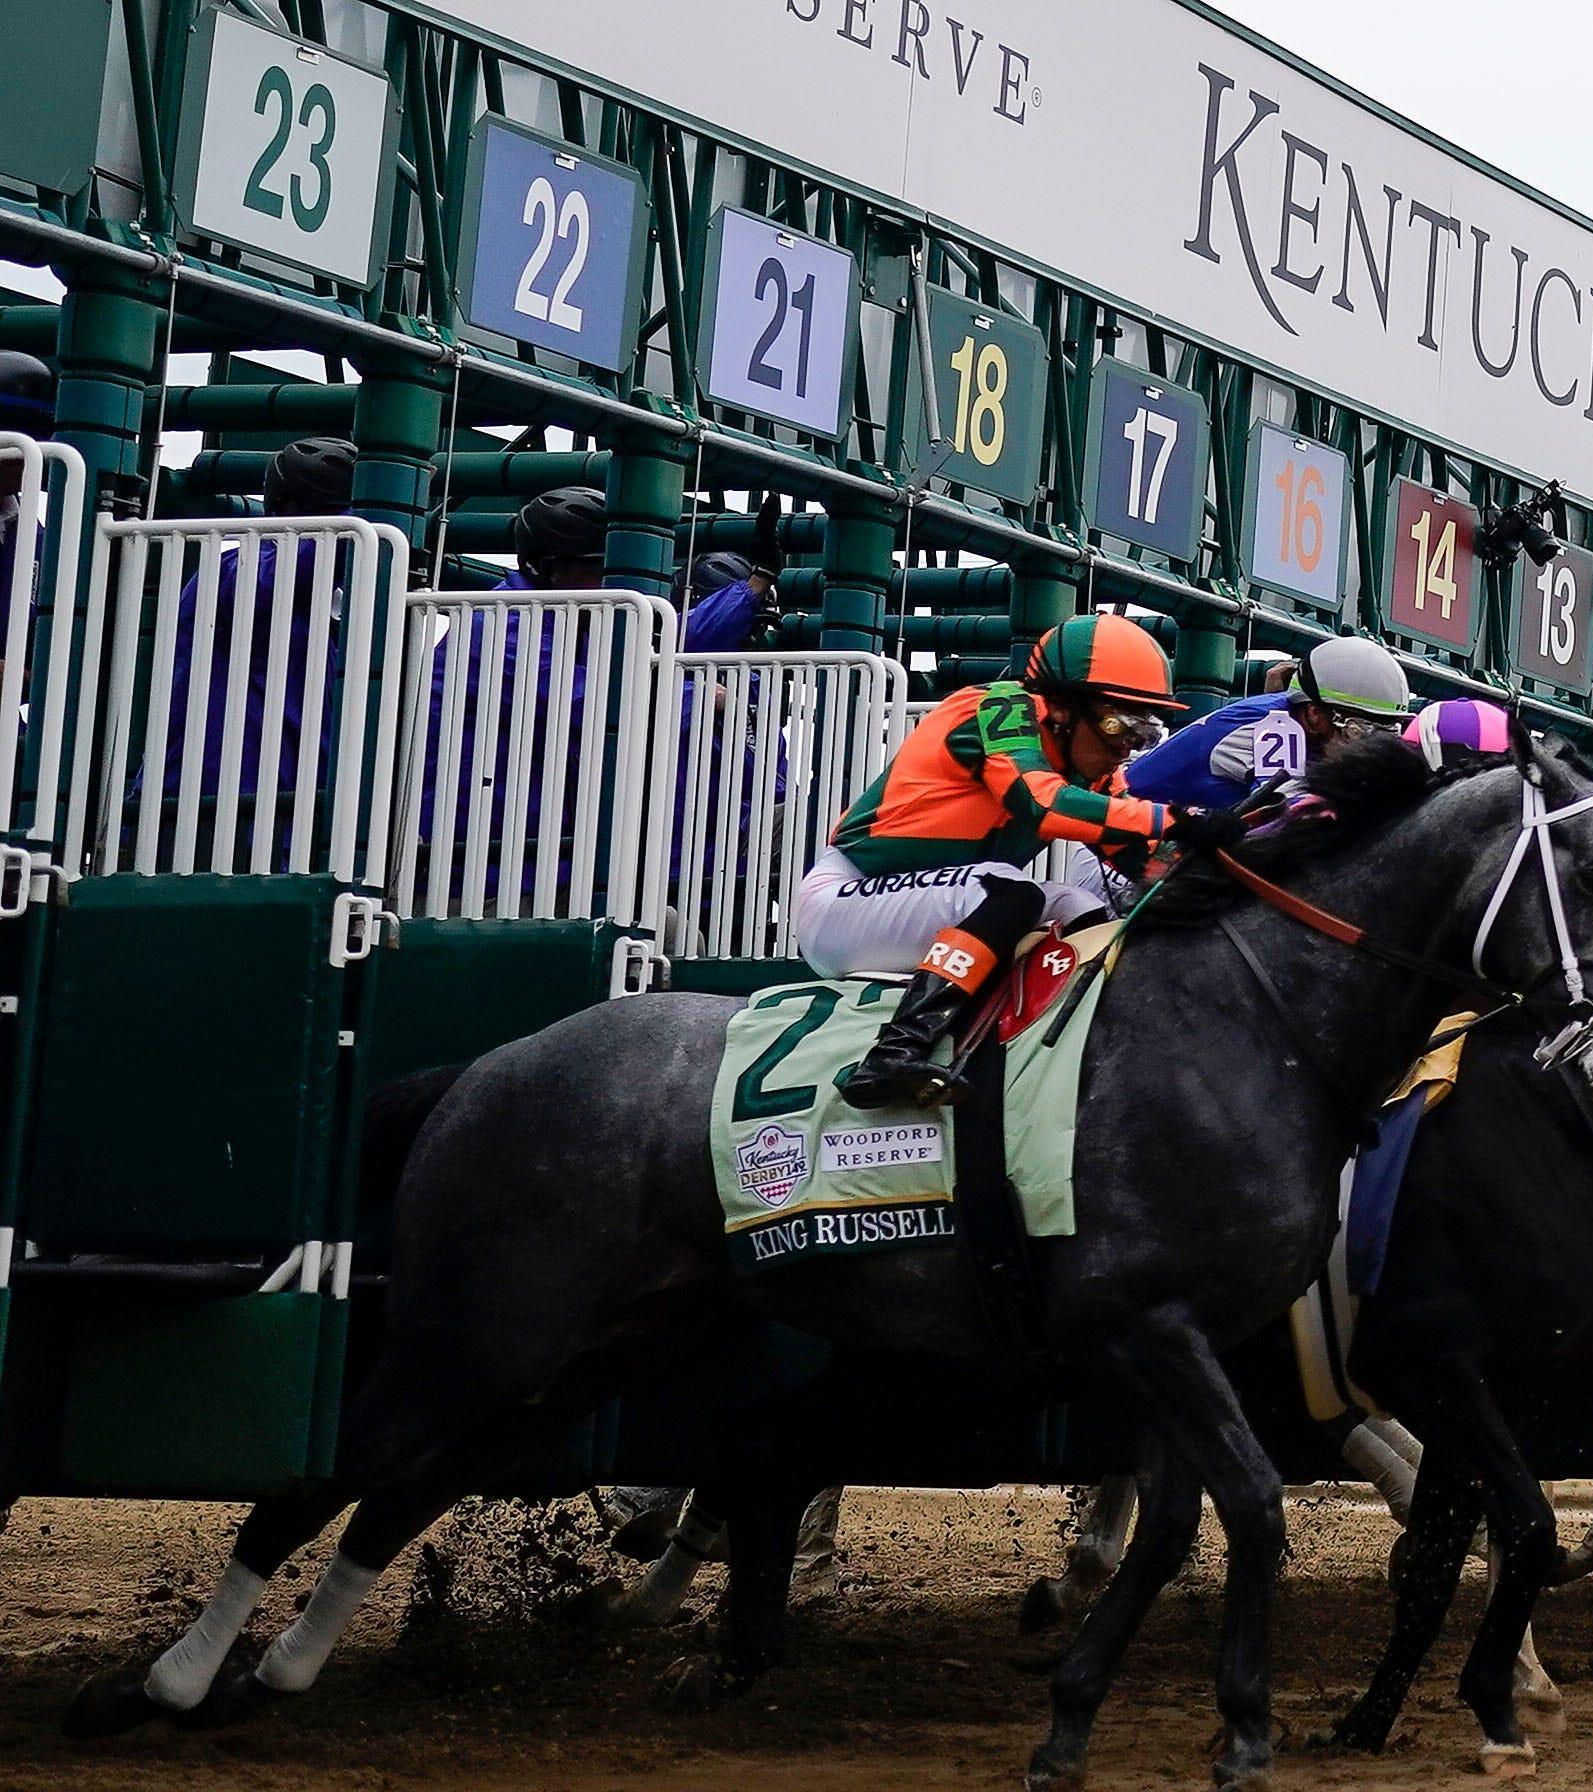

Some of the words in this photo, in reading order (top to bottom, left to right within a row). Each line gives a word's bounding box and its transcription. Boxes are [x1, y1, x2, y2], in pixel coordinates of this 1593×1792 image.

[787, 0, 1029, 125] ERVE
[243, 65, 337, 233] 23
[514, 176, 590, 333] 22
[747, 256, 816, 398] 21
[950, 335, 1007, 466] 18
[1124, 407, 1178, 524] 17
[1275, 459, 1325, 574] 16
[1410, 511, 1458, 620] 14
[1536, 561, 1577, 667] 13
[979, 693, 1040, 742] 23
[1261, 732, 1298, 769] 21
[923, 941, 975, 979] RB
[744, 1145, 800, 1168] Kentucky
[824, 1127, 939, 1147] WOODFORD
[837, 1147, 930, 1167] RESERVE
[750, 1218, 809, 1261] KING
[814, 1206, 955, 1245] RUSSELL
